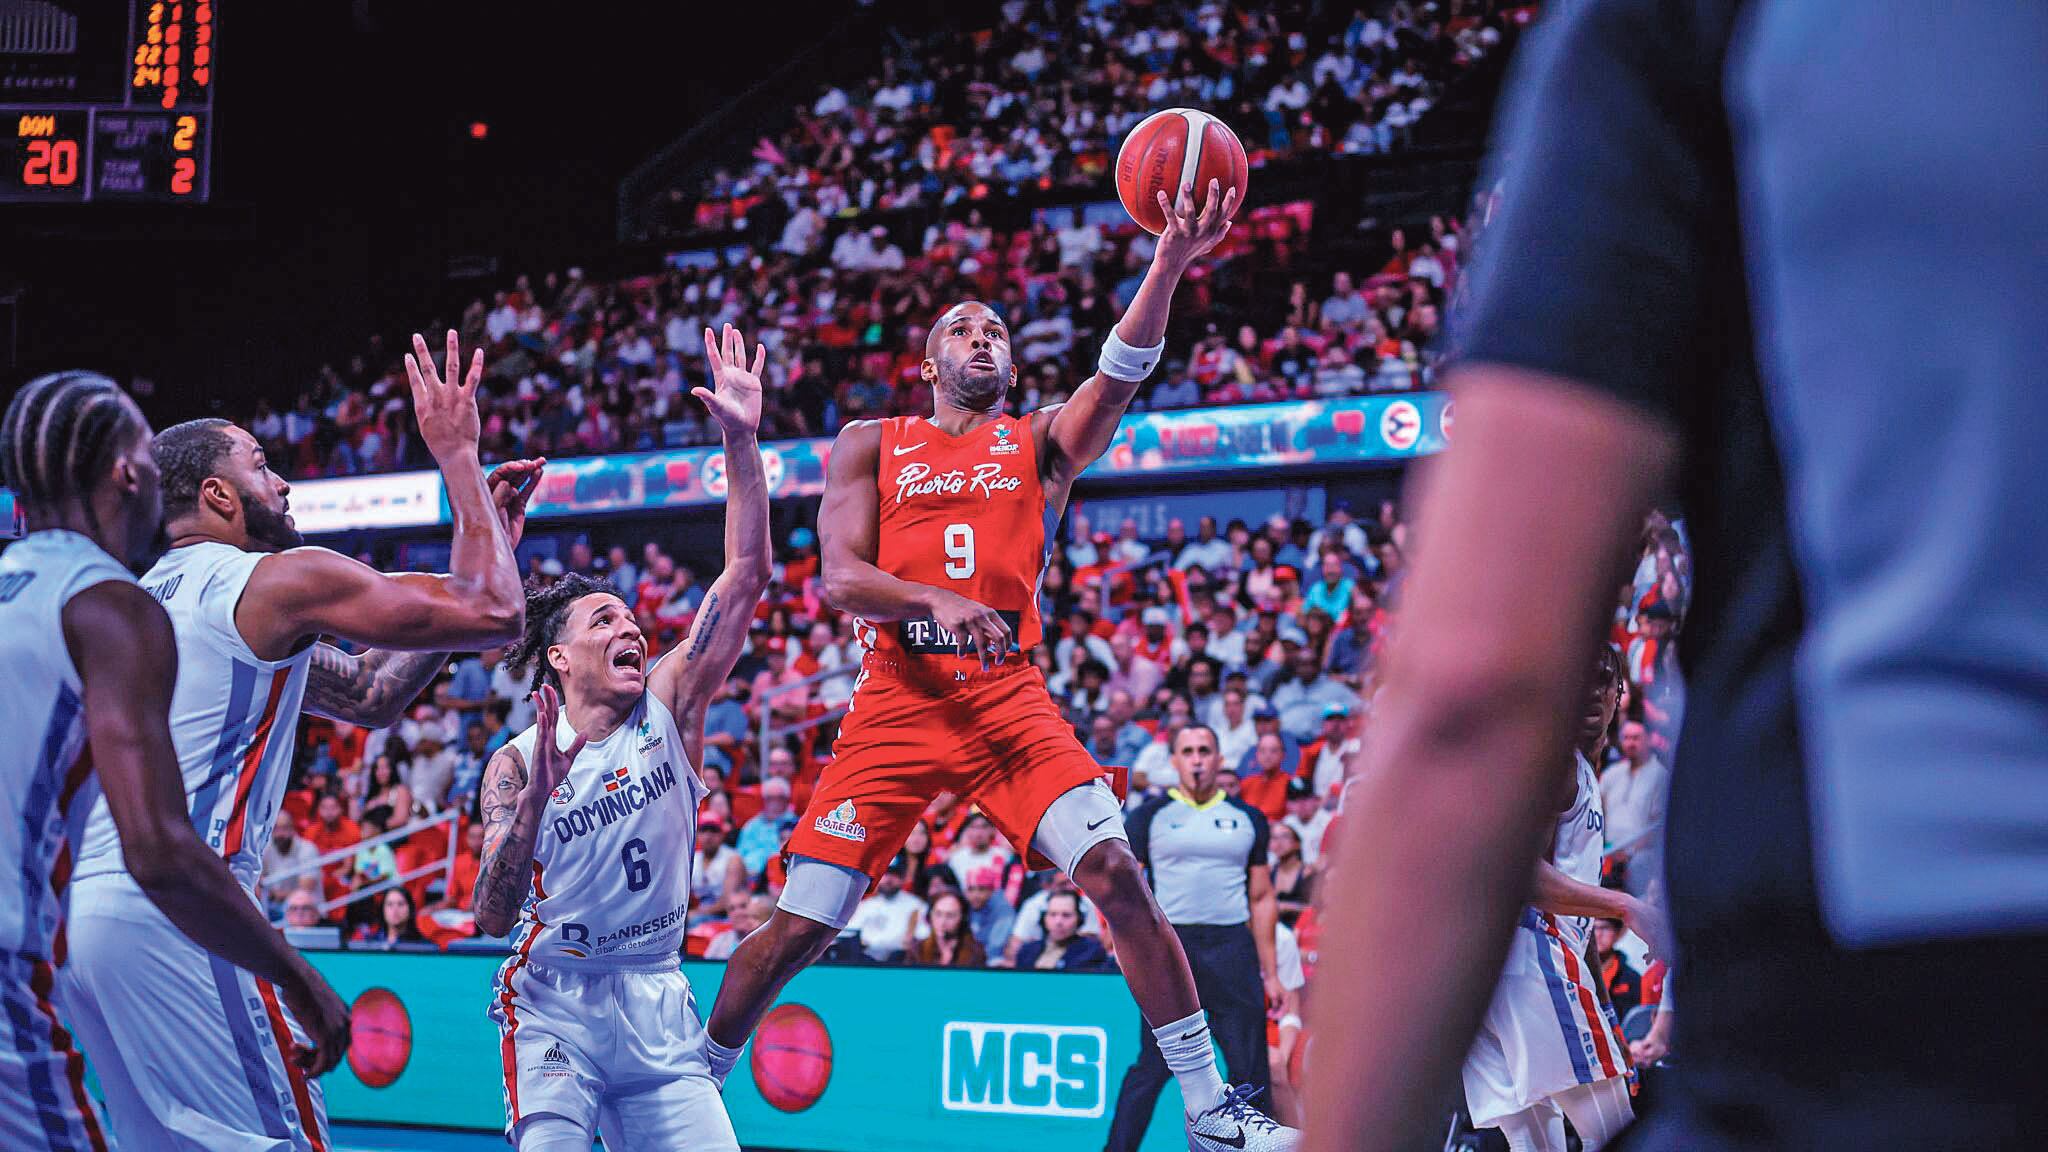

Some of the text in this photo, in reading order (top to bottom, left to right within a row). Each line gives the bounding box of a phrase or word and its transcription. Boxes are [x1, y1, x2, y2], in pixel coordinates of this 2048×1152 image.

[18, 116, 55, 137] DOM
[173, 116, 197, 150] 2
[23, 140, 77, 185] 20
[171, 158, 196, 195] 2
[895, 462, 1022, 504] Puerto Rico
[943, 523, 976, 580] 9
[553, 761, 677, 845] DOMINICANA
[815, 816, 865, 838] LOTERÍA
[621, 838, 652, 892] 6
[949, 1029, 1100, 1109] MCS
